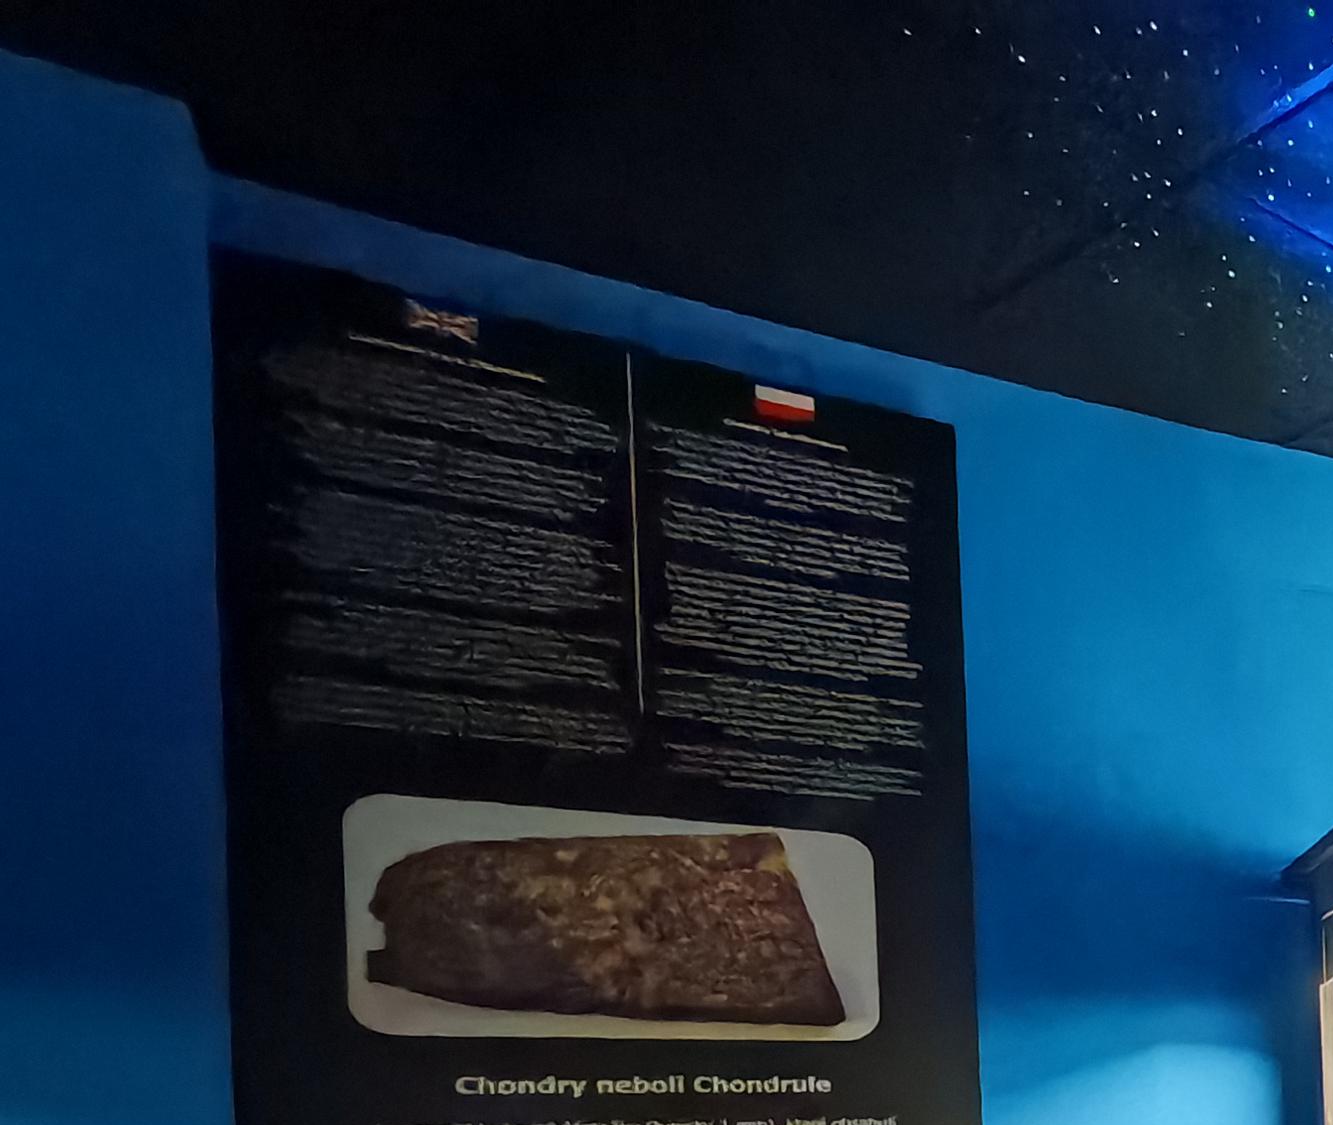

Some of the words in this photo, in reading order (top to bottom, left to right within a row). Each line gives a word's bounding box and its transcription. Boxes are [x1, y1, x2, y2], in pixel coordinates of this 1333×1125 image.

[455, 1076, 587, 1098] Chondry
[597, 1074, 685, 1095] neboli
[693, 1075, 832, 1095] Chondrule
